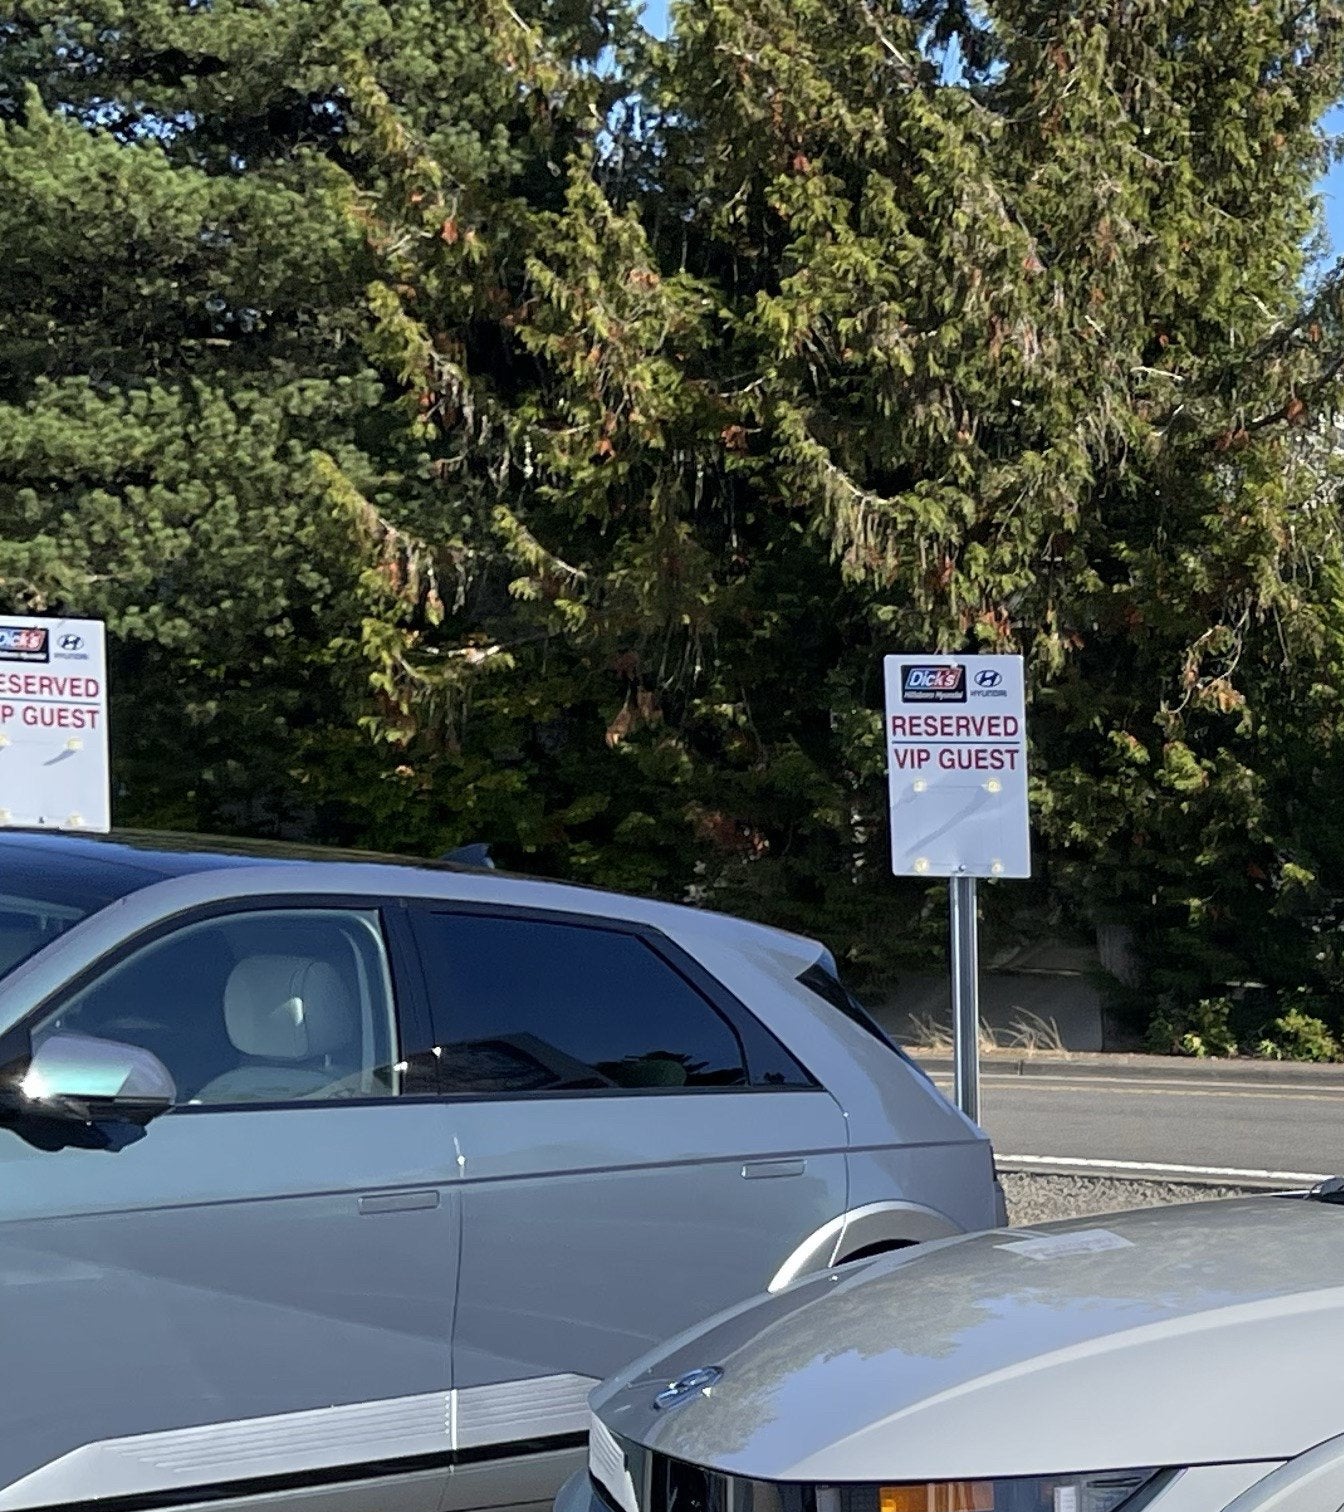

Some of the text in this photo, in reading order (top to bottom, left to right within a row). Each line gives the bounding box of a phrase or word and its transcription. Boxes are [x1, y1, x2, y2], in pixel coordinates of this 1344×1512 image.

[23, 705, 99, 729] GUEST
[891, 715, 1019, 737] RESERVED
[893, 748, 1019, 770] VIP GUEST
